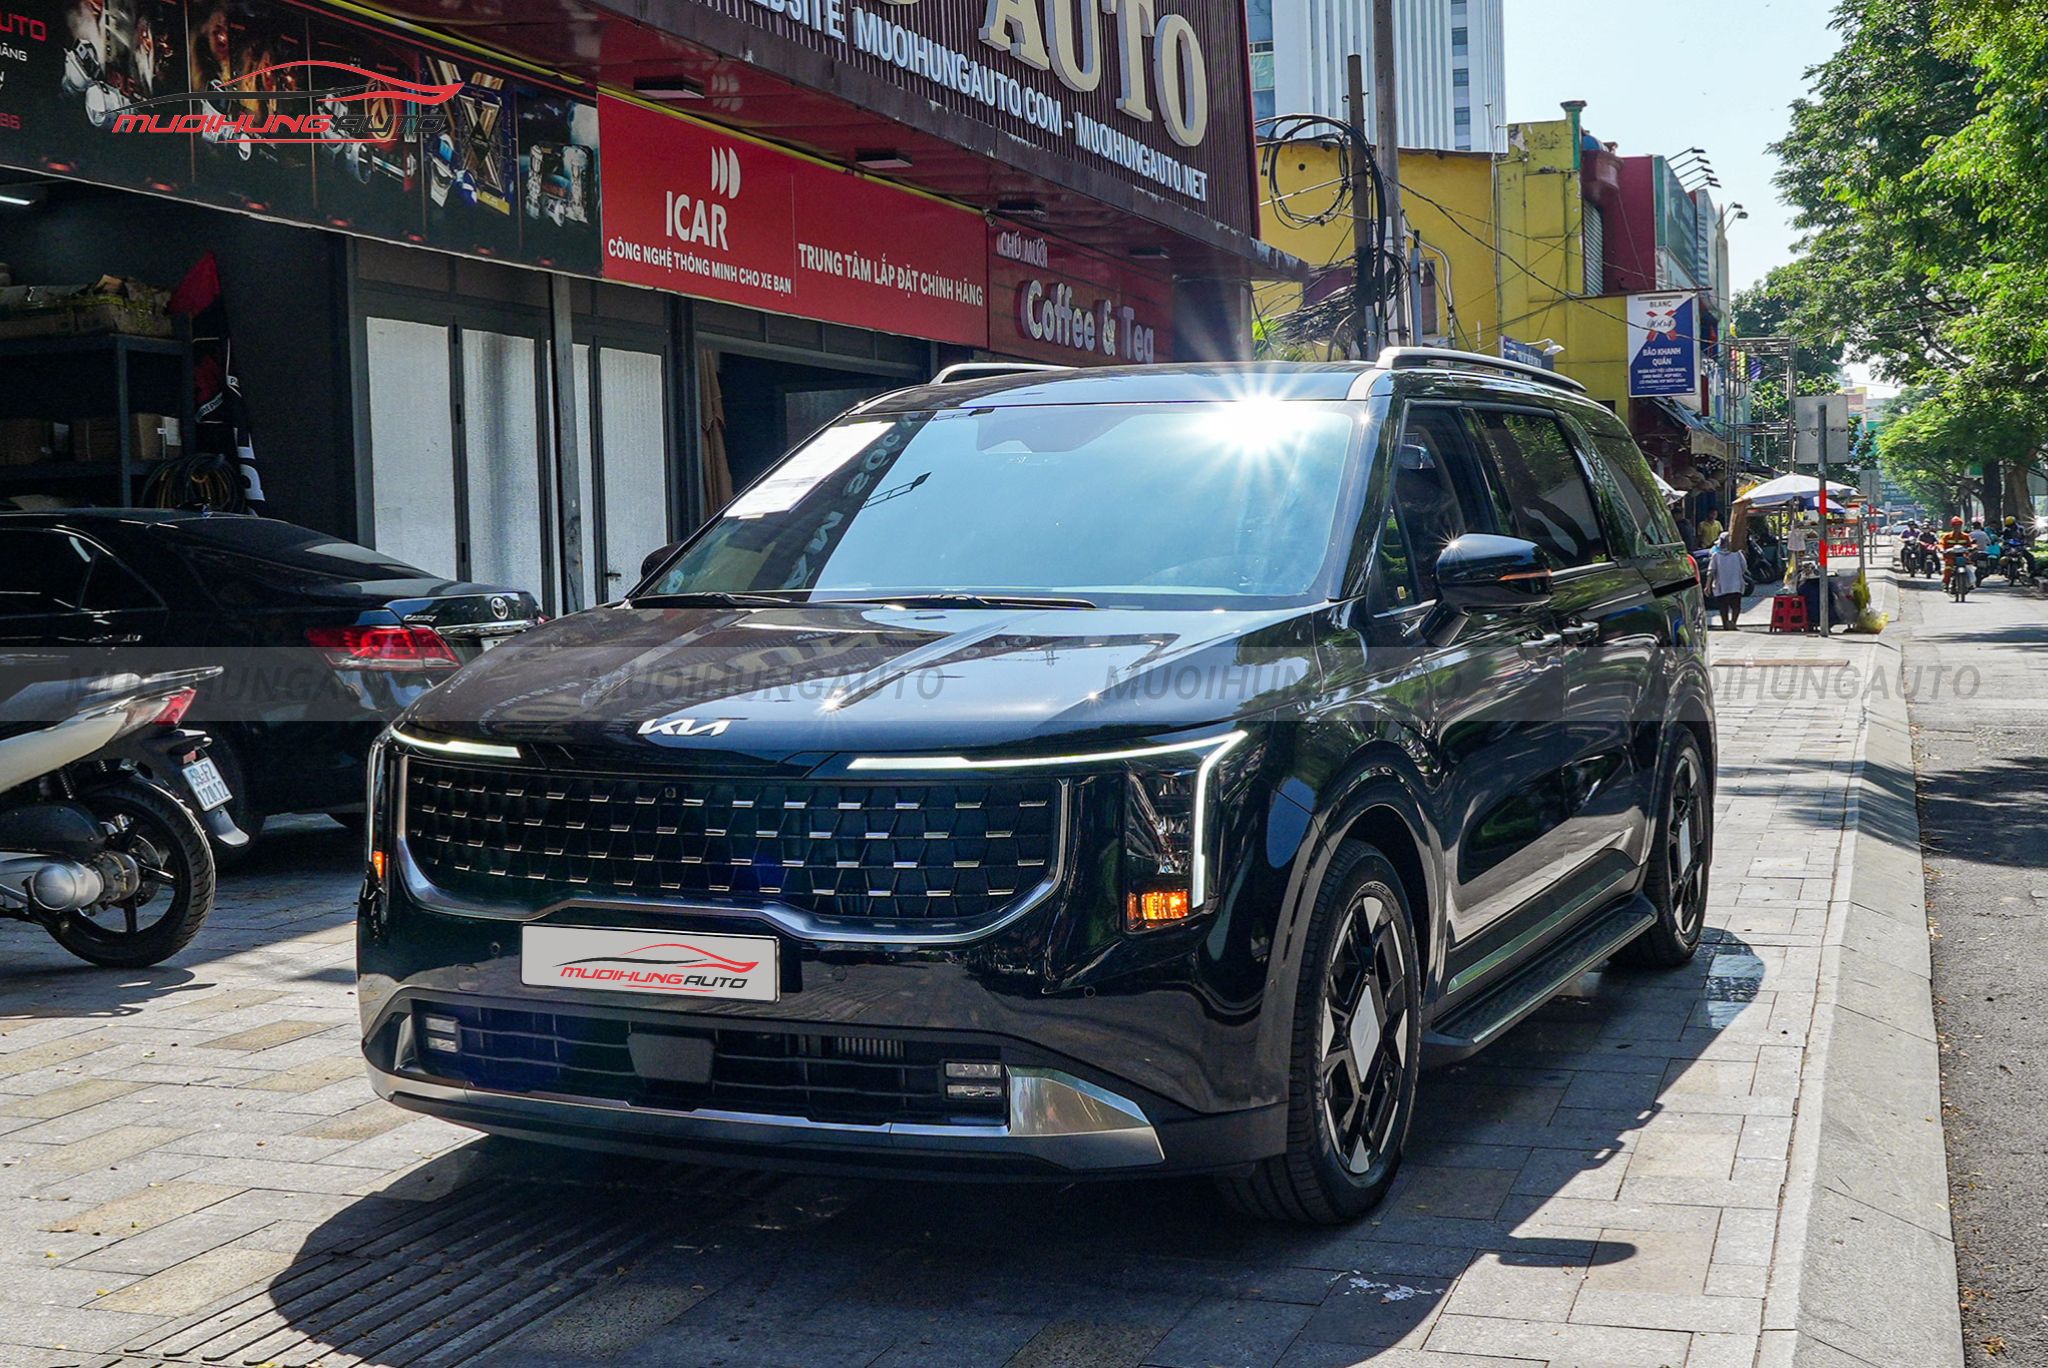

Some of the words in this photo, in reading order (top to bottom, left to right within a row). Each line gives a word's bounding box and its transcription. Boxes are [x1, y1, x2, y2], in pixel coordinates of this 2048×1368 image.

[852, 7, 1063, 137] MUOIHUNGAUTO.COM
[1075, 111, 1208, 202] MUOIHUNGAUTO.NET
[979, 0, 1208, 147] AUTO
[666, 190, 729, 251] ICAR
[608, 236, 641, 261] CÔNG
[643, 245, 673, 273] NGHỆ
[674, 252, 710, 275] THÔNG
[712, 261, 738, 283] MINH
[739, 268, 760, 287] CHO
[760, 272, 773, 289] XE
[773, 276, 792, 297] BẠN
[798, 242, 843, 277] TRUNG
[844, 250, 872, 283] TÂM
[873, 253, 896, 287] LẮP
[897, 264, 919, 298] ĐẶT
[920, 270, 954, 300] CHÍNH
[955, 278, 984, 307] HÀNG
[1022, 279, 1096, 351] Coffee
[1101, 299, 1116, 356] &
[1119, 305, 1154, 364] Tea
